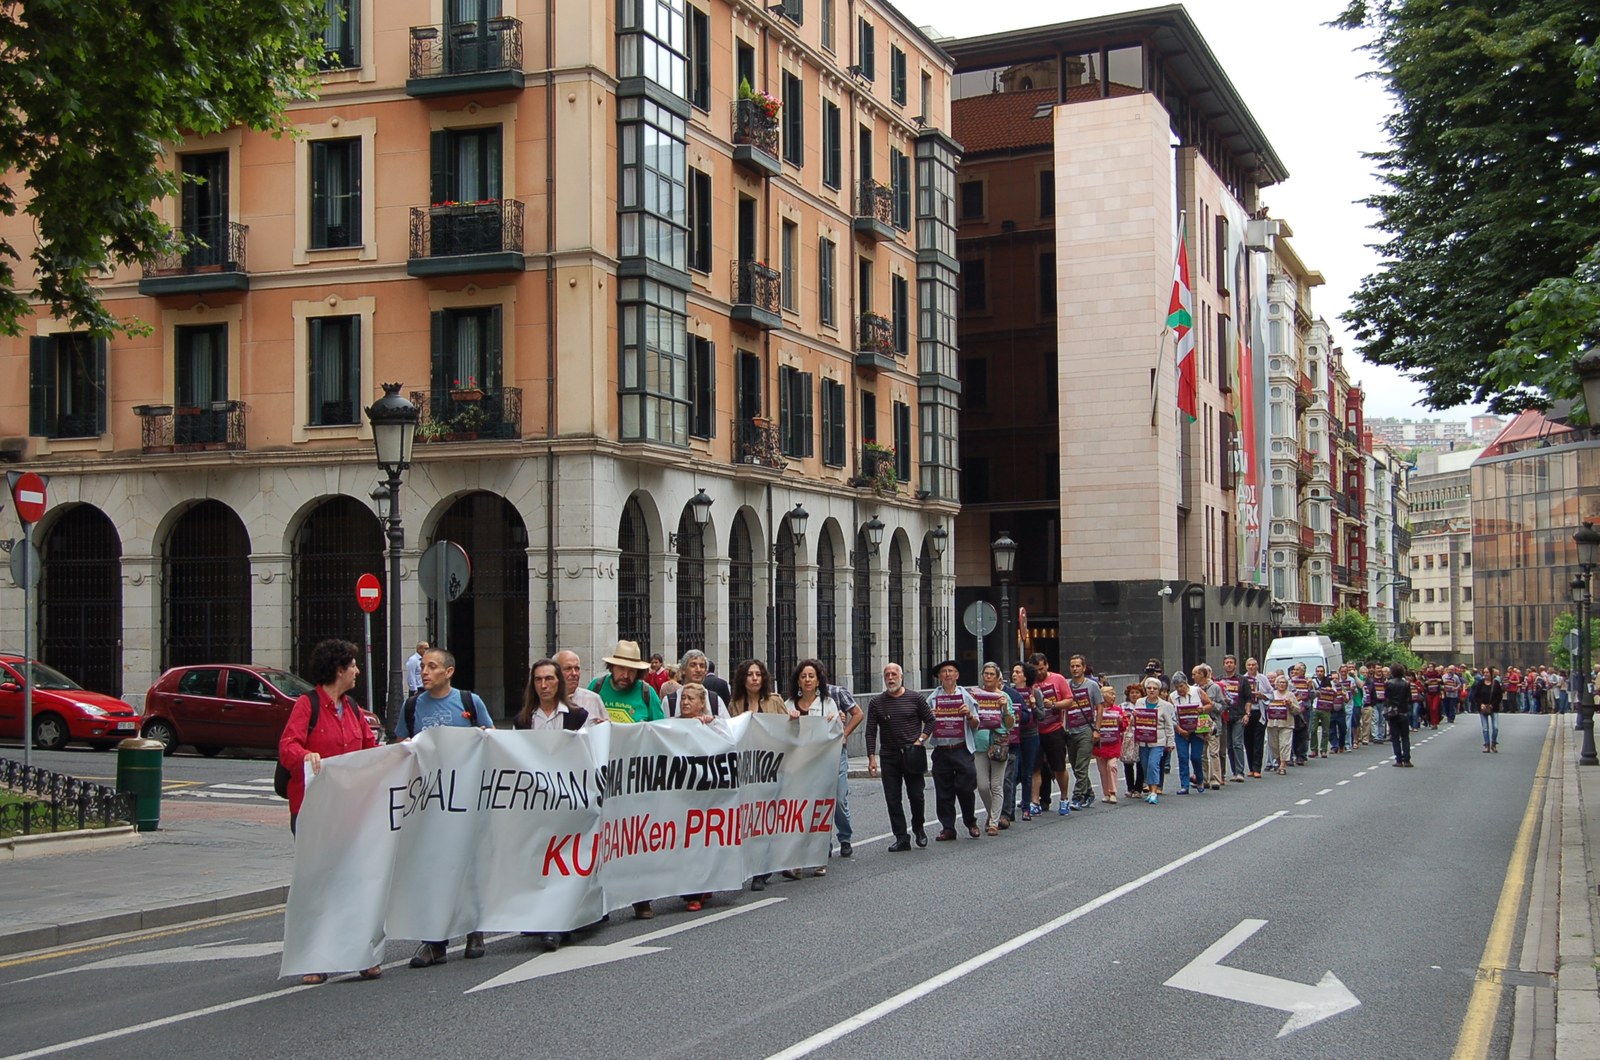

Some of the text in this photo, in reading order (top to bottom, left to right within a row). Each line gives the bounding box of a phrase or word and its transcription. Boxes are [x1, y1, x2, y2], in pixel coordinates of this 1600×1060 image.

[389, 769, 467, 831] ESKAL
[477, 769, 589, 811] HERRIAN
[627, 752, 742, 794] FINANTZIER
[809, 798, 835, 833] EZ
